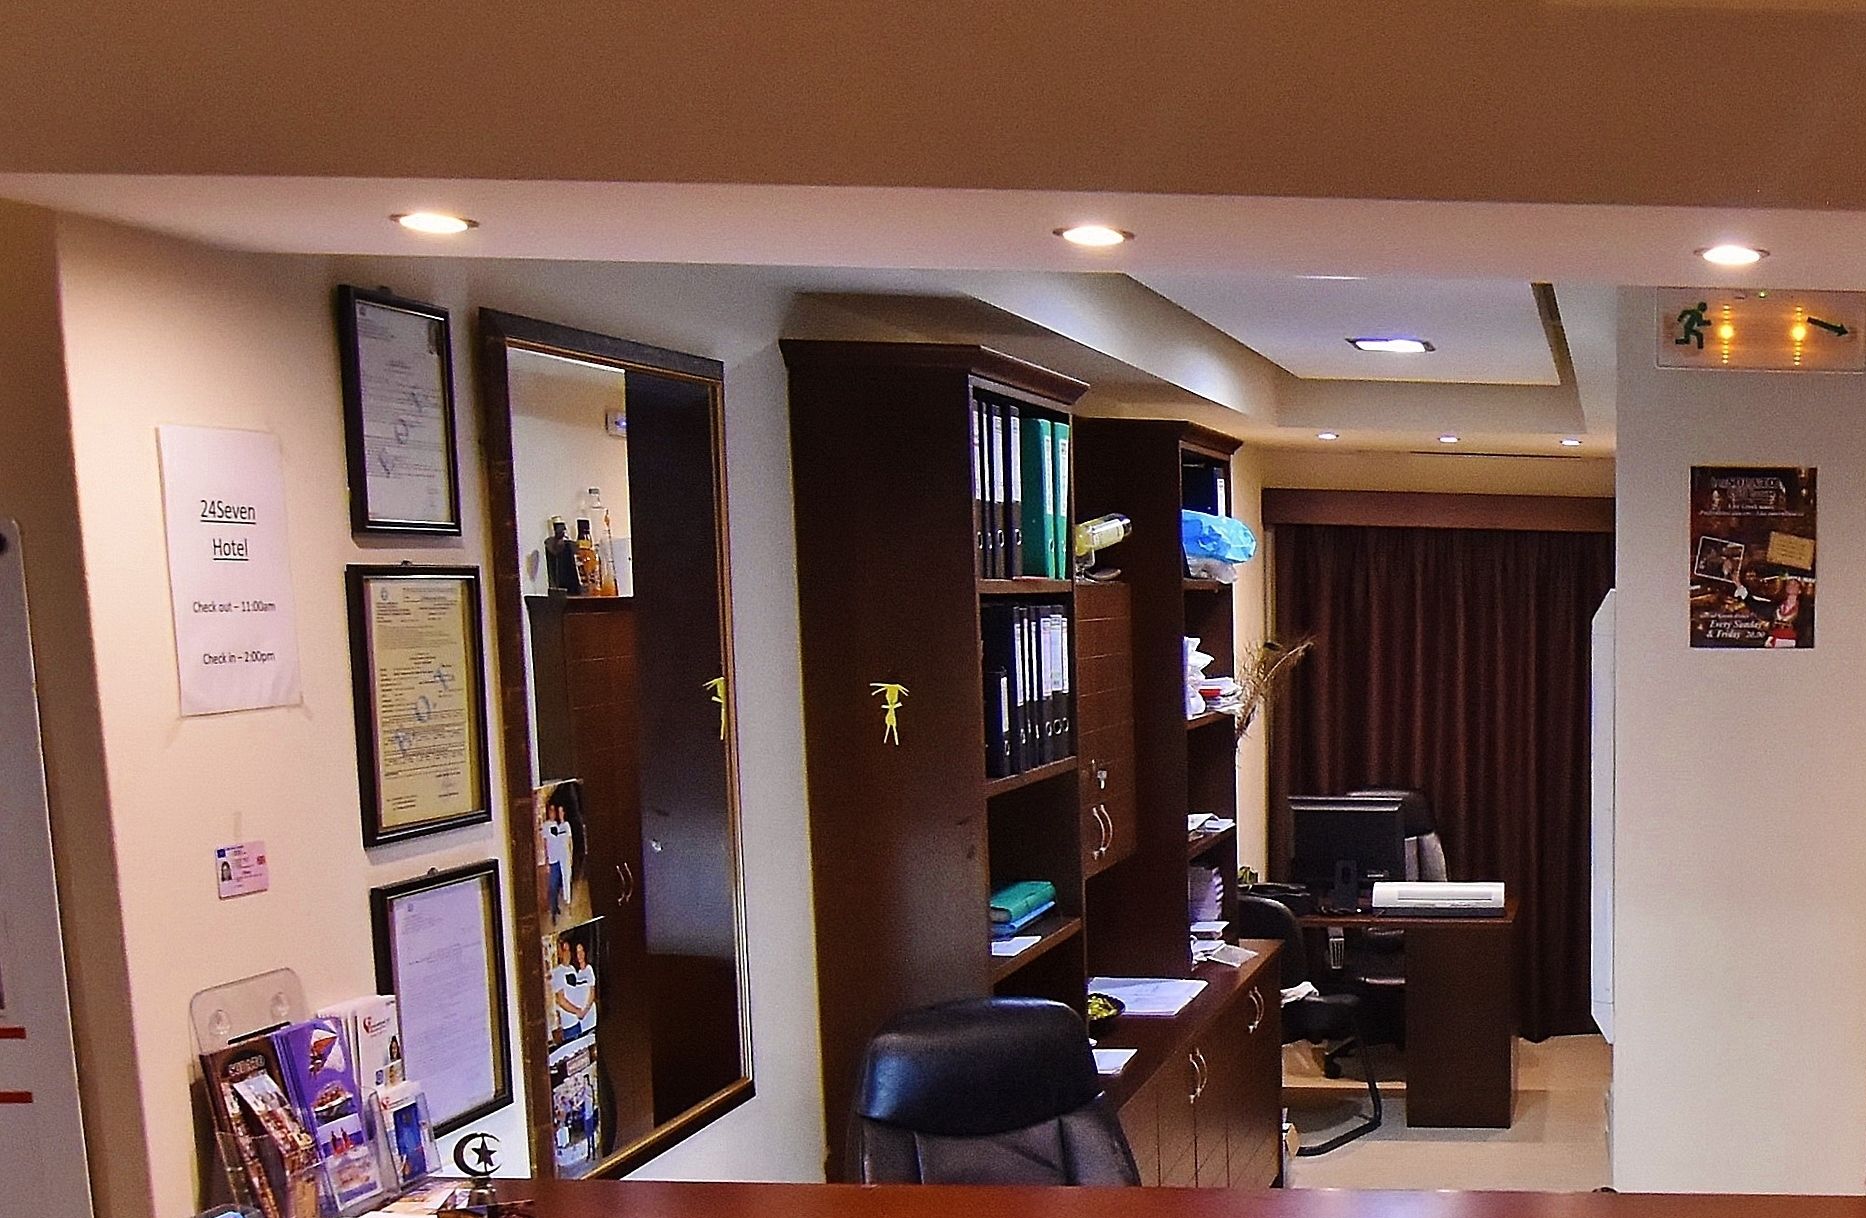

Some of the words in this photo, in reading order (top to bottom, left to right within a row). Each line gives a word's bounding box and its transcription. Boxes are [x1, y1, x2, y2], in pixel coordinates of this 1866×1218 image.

[200, 499, 256, 521] 24Seven
[212, 538, 249, 556] Hotel
[193, 602, 216, 613] Check
[218, 603, 232, 612] out
[241, 600, 276, 612] 11:00am
[203, 653, 226, 665] Check
[229, 653, 236, 664] in
[245, 651, 275, 665] 2:00pm
